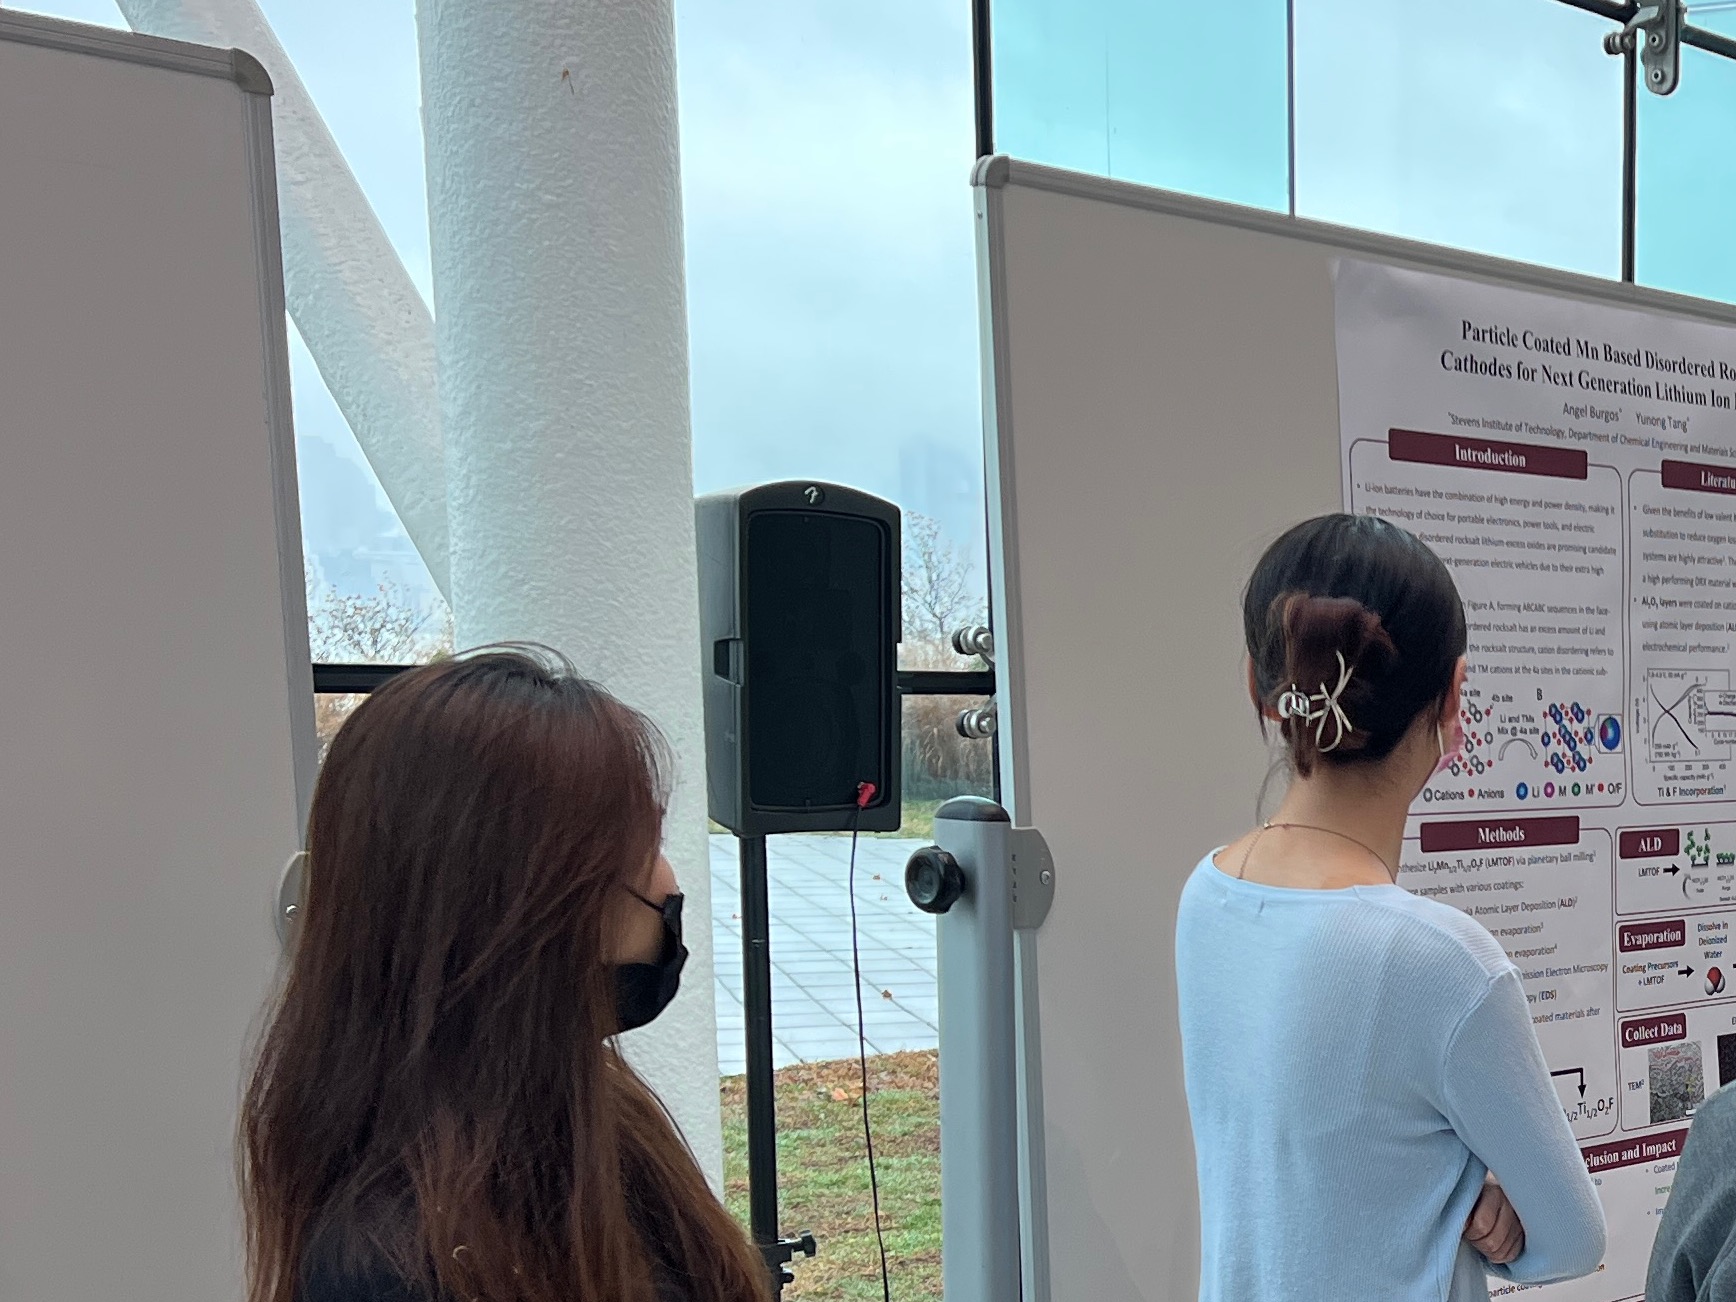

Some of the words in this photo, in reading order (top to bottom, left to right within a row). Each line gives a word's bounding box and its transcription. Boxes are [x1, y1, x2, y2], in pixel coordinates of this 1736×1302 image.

[1461, 321, 1518, 346] Particle
[1522, 330, 1570, 355] Coated
[1576, 338, 1599, 360] Mn
[1603, 343, 1640, 365] Based
[1645, 351, 1715, 375] Disordered
[1440, 350, 1512, 377] Cathodes
[1516, 360, 1537, 382] for
[1541, 364, 1573, 387] Next
[1578, 370, 1651, 396] Generation
[1655, 381, 1706, 404] Lithium
[1710, 388, 1730, 409] Ion
[1562, 402, 1587, 419] Angel
[1636, 412, 1665, 429] Yunong
[1482, 417, 1512, 432] Institute
[1514, 420, 1523, 434] of
[1525, 422, 1566, 438] Technology,
[1568, 428, 1608, 443] Department
[1611, 432, 1618, 445] of
[1619, 433, 1649, 448] Chemical
[1651, 437, 1688, 452] Engineering
[1689, 441, 1700, 454] and
[1455, 445, 1525, 465] Introduction
[1415, 486, 1430, 500] have
[1432, 488, 1443, 501] the
[1445, 489, 1484, 504] combination
[1494, 493, 1508, 506] high
[1509, 495, 1529, 508] energy
[1532, 497, 1542, 509] and
[1544, 498, 1562, 511] power
[1588, 502, 1607, 514] making
[1377, 507, 1414, 520] technology
[1424, 510, 1444, 522] choice
[1457, 513, 1484, 525] portable
[1487, 515, 1521, 528] electronics,
[1523, 518, 1541, 530] power
[1643, 505, 1660, 516] Given
[1661, 507, 1671, 518] the
[1673, 508, 1695, 519] benefits
[1697, 510, 1703, 520] of
[1454, 534, 1479, 547] rocksalt
[1643, 528, 1678, 541] substitution
[1686, 531, 1705, 543] reduce
[1490, 558, 1513, 570] electric
[1515, 559, 1537, 572] vehicles
[1647, 573, 1659, 586] high
[1661, 574, 1693, 587] performing
[1467, 600, 1486, 611] Figure
[1660, 597, 1677, 609] layers
[1693, 599, 1712, 611] coated
[1659, 620, 1678, 632] atomic
[1679, 621, 1693, 632] layer
[1694, 622, 1724, 633] deposition
[1481, 643, 1506, 654] rocksalt
[1642, 642, 1686, 652] electrochemical
[1536, 688, 1542, 700] B
[1508, 714, 1519, 723] and
[1497, 727, 1508, 736] Mix
[1519, 727, 1527, 735] 4a
[1528, 727, 1539, 735] site
[1434, 789, 1464, 801] Cations
[1477, 788, 1504, 799] Anions
[1532, 786, 1539, 797] Li
[1558, 785, 1566, 796] M
[1608, 784, 1621, 795] O/F
[1657, 787, 1664, 798] Ti
[1666, 786, 1671, 797] &
[1672, 786, 1677, 797] F
[1478, 826, 1524, 842] Methods
[1638, 837, 1662, 852] ALD
[1485, 856, 1514, 869] (LMTOF)
[1516, 855, 1526, 867] via
[1527, 853, 1558, 866] planetary
[1559, 852, 1571, 865] ball
[1638, 868, 1660, 877] LMTOF
[1420, 886, 1447, 897] samples
[1449, 884, 1463, 895] with
[1465, 883, 1491, 894] various
[1475, 903, 1498, 915] Atomic
[1501, 901, 1519, 913] Layer
[1521, 899, 1555, 911] Deposition
[1697, 922, 1720, 932] Dissolve
[1623, 928, 1681, 946] Evaporation
[1698, 935, 1727, 945] Deionized
[1703, 950, 1722, 959] Water
[1546, 966, 1571, 978] Electron
[1573, 963, 1608, 974] Microscopy
[1622, 964, 1646, 974] Coating
[1648, 960, 1678, 971] Precursors
[1643, 976, 1664, 986] LMTOF
[1538, 990, 1556, 1001] (EDS)
[1555, 1009, 1584, 1020] materials
[1586, 1006, 1600, 1017] after
[1625, 1024, 1658, 1041] Collect
[1660, 1020, 1682, 1036] Data
[1584, 1149, 1618, 1170] clusion
[1621, 1144, 1639, 1164] and
[1642, 1138, 1675, 1159] Impact
[1654, 1162, 1675, 1173] Coated
